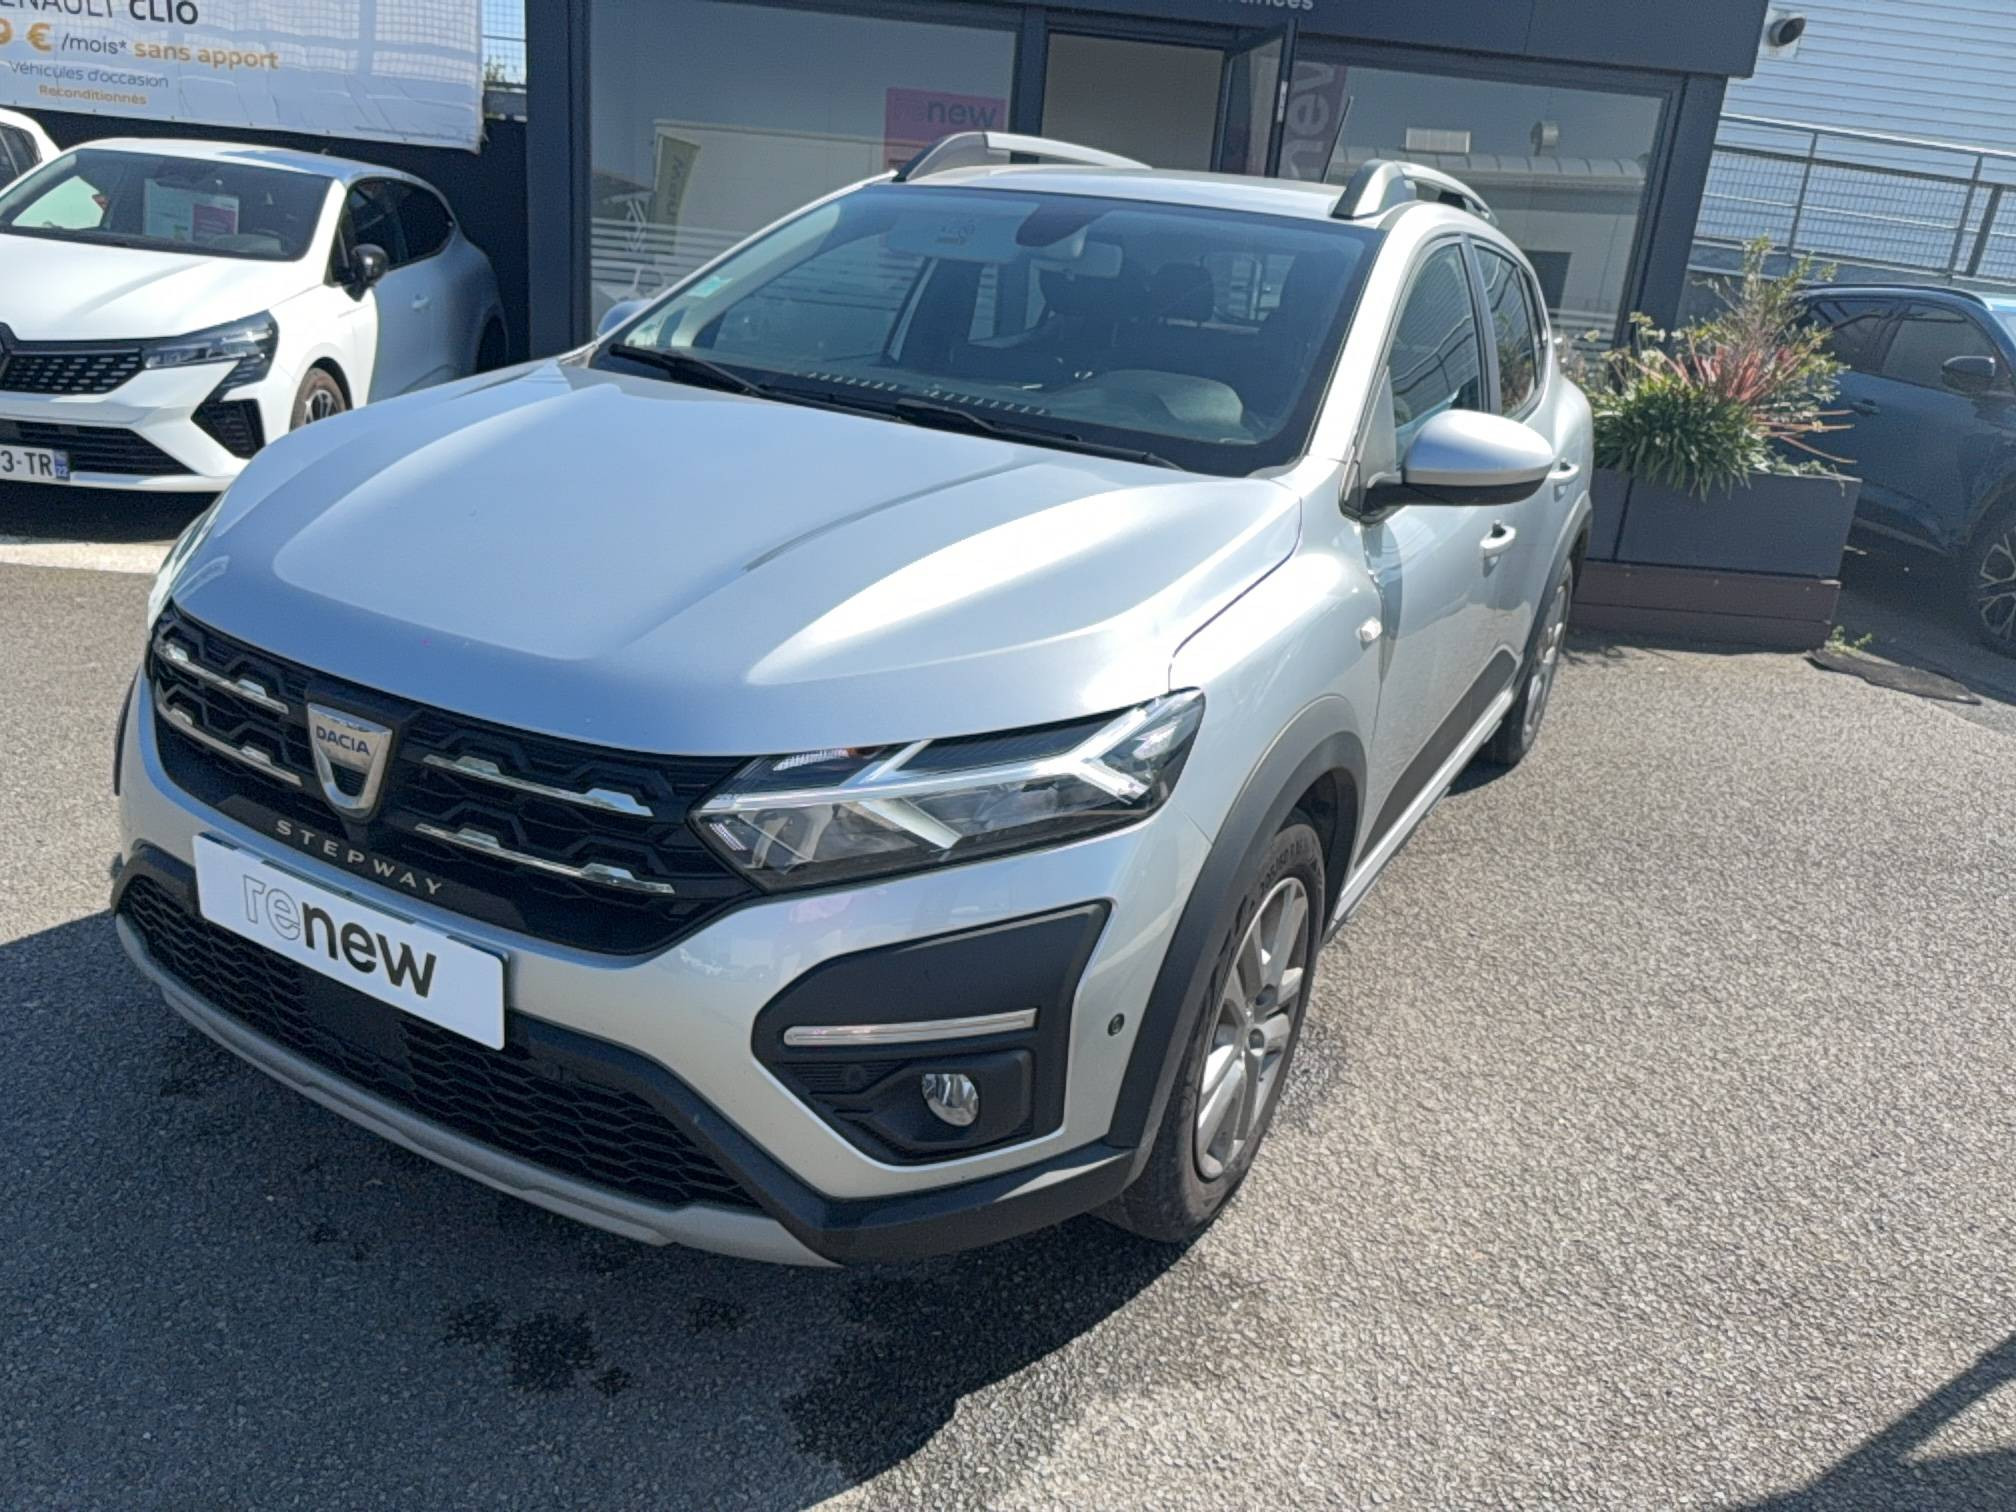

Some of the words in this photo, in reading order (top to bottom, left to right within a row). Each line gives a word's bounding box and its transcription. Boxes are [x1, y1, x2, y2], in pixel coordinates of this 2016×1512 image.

[129, 0, 198, 25] CLIO
[27, 22, 53, 52] €
[134, 41, 190, 61] sans
[197, 47, 279, 71] apport
[9, 60, 84, 80] Véhicules
[87, 69, 169, 89] d'occasion
[38, 84, 148, 105] Reconditionnés
[315, 725, 371, 756] DACIA
[275, 819, 443, 896] STEPWAY
[242, 874, 437, 999] renew
